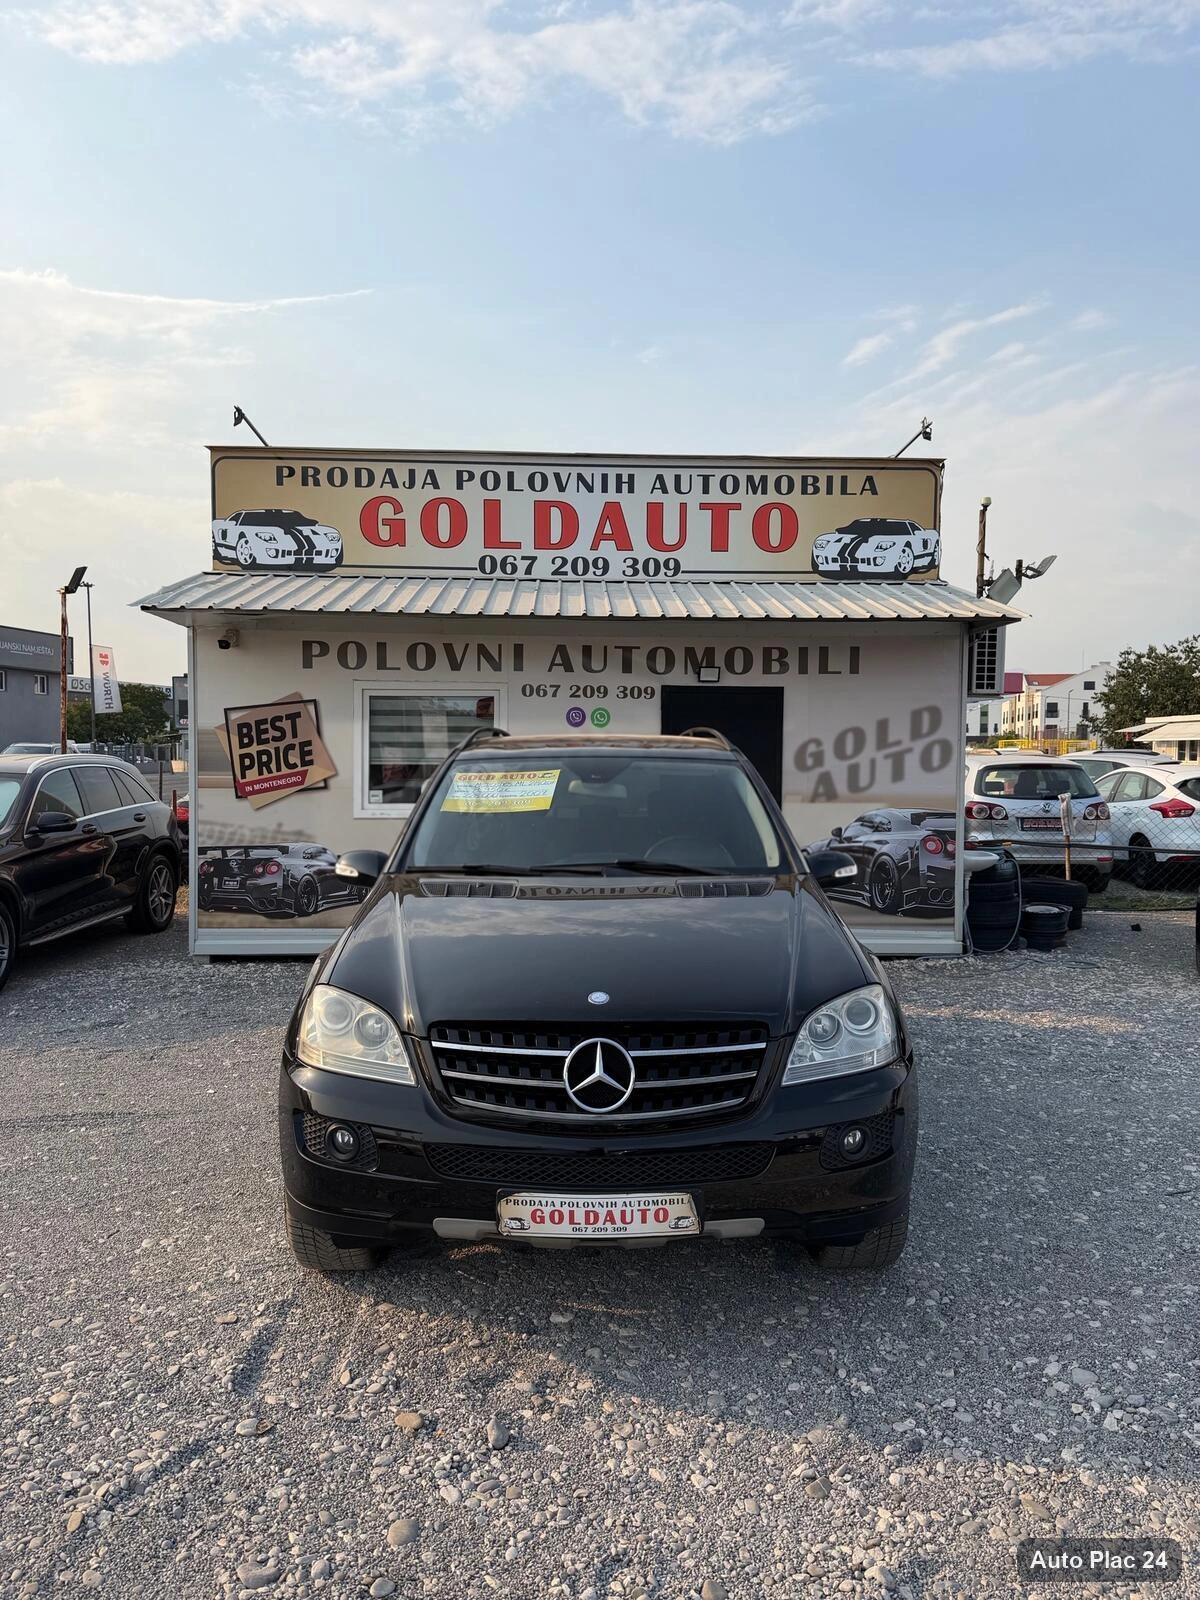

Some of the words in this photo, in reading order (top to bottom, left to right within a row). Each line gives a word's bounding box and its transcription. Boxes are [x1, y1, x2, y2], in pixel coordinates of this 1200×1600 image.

[275, 465, 441, 490] PRODAJA
[456, 469, 636, 494] POLOVNIH
[650, 474, 879, 497] AUTOMOBILA
[360, 495, 799, 554] GOLDAUTO
[478, 555, 538, 577] 067
[551, 556, 610, 577] 209
[622, 556, 681, 578] 309
[302, 640, 524, 672] POLOVNI
[547, 643, 862, 676] AUTOMOBILI
[521, 683, 561, 698] 067
[569, 684, 608, 699] 209
[616, 685, 655, 700] 309
[236, 711, 302, 750] BEST
[793, 704, 942, 773] GOLD
[238, 740, 314, 780] PRICE
[500, 772, 537, 780] AUTO
[810, 738, 953, 803] AUTO
[253, 775, 302, 791] MONTENEGRO
[505, 1198, 556, 1208] PRODAJA
[560, 1200, 618, 1209] POLOVNIH
[530, 1207, 670, 1226] GOLDAUTO
